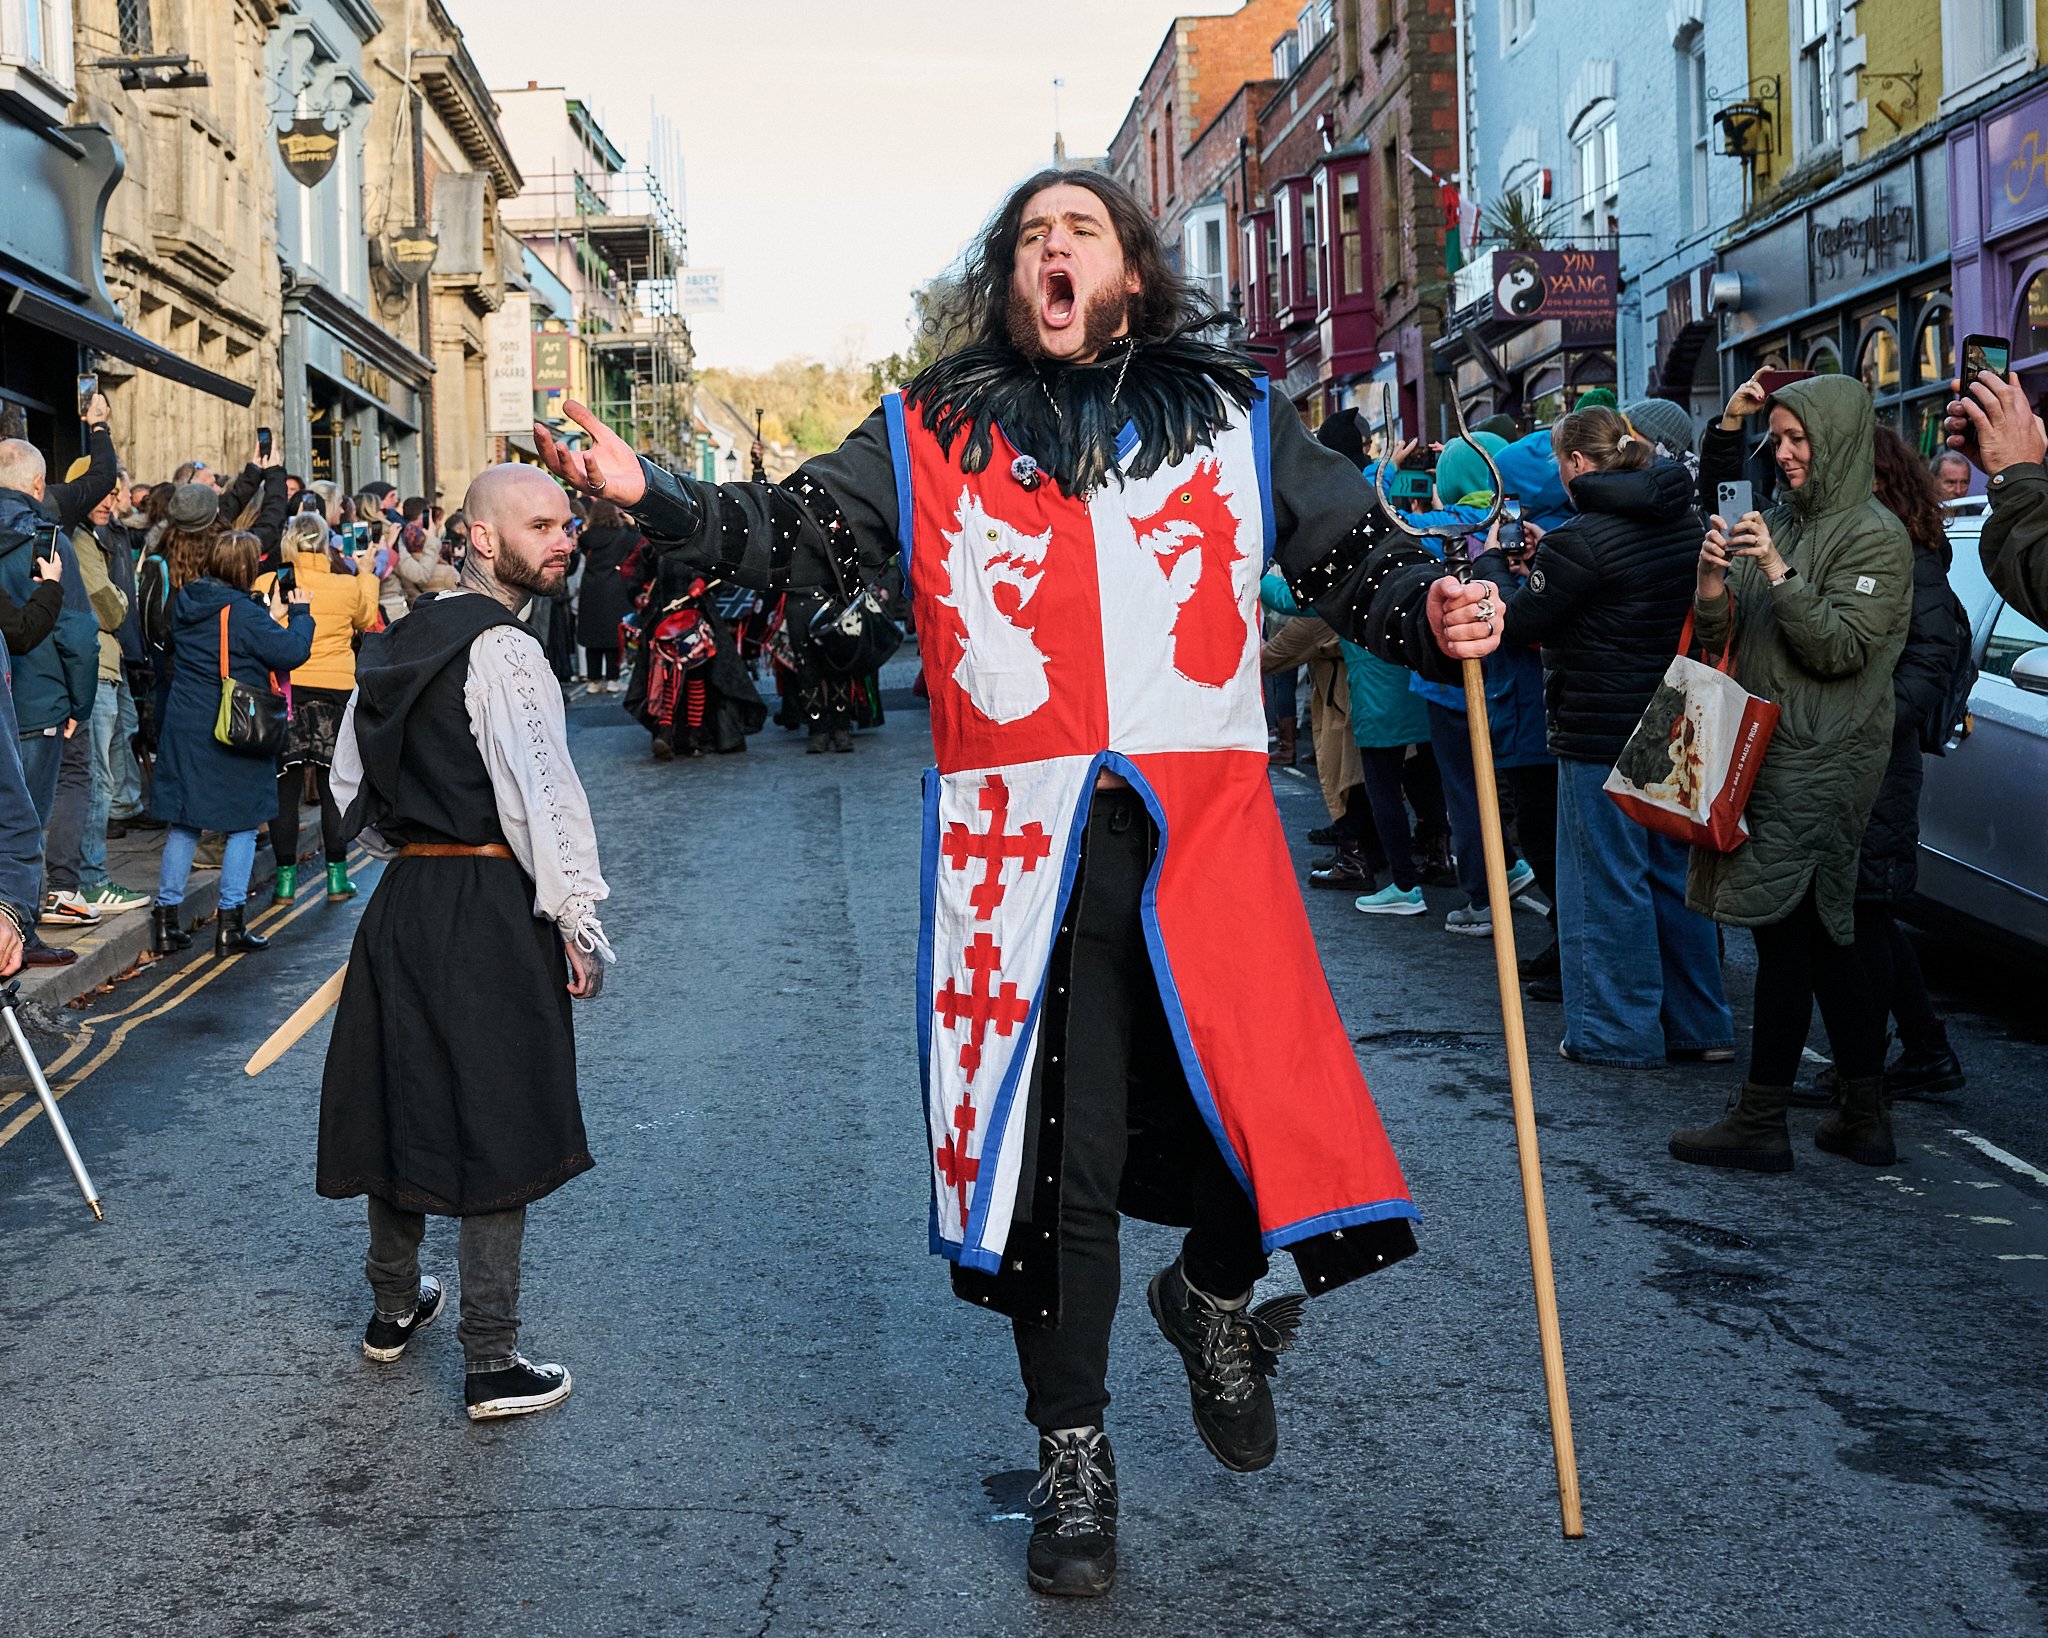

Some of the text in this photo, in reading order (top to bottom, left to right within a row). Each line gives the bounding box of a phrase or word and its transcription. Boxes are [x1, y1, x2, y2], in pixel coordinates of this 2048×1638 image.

[1562, 254, 1595, 273] YIN
[1549, 275, 1607, 295] YANG
[499, 341, 521, 352] SONS
[542, 342, 562, 352] Art
[504, 354, 515, 364] OF
[544, 355, 558, 365] of
[493, 367, 527, 378] ASGARD
[536, 368, 568, 380] Africa
[1740, 743, 1752, 763] MADE
[1747, 721, 1760, 742] FROM
